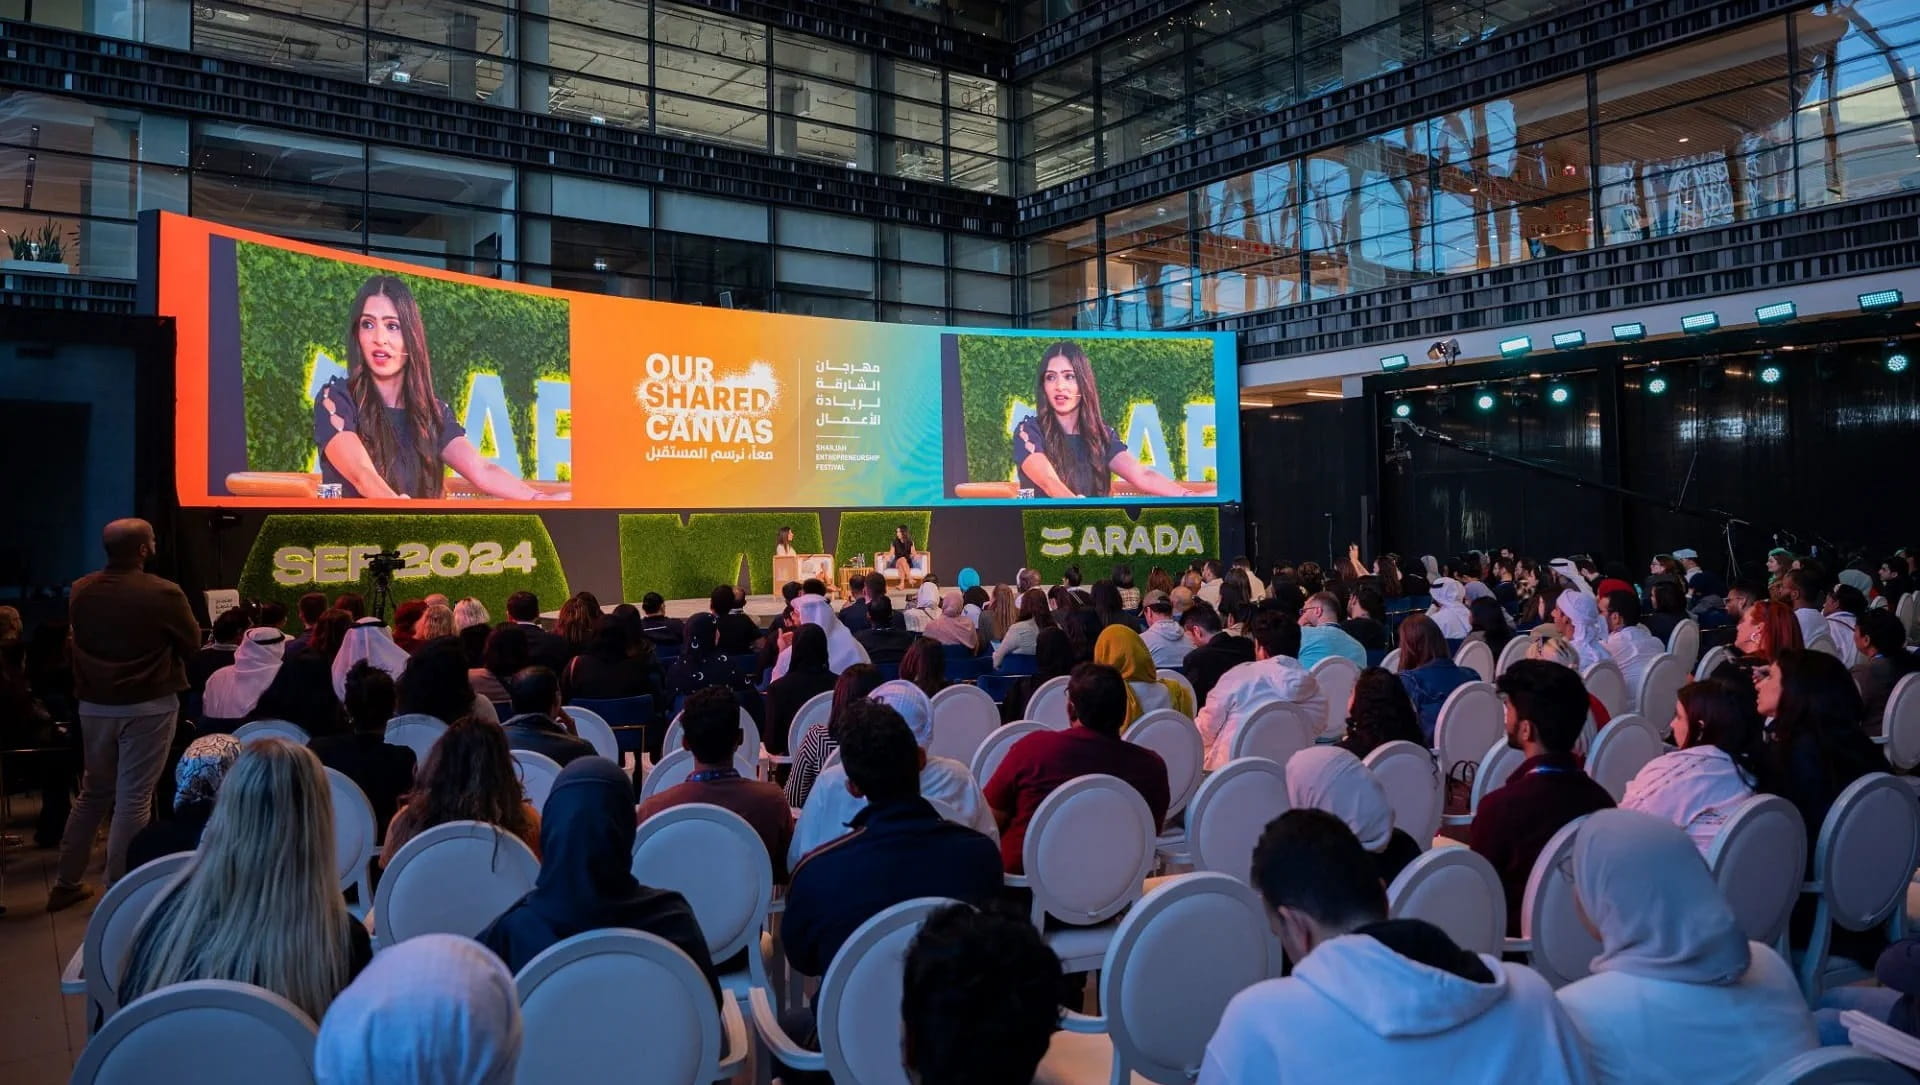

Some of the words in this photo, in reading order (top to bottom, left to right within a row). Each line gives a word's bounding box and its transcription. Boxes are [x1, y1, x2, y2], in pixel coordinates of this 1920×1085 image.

[645, 353, 714, 383] OUR
[815, 359, 880, 374] مهرجان
[815, 376, 880, 392] الشارقة
[645, 381, 771, 411] SHARED
[815, 393, 881, 410] لريادة
[815, 412, 881, 427] الأعمال
[645, 415, 774, 444] CANVAS
[645, 445, 708, 461] المستقبل
[711, 447, 745, 463] نرسم
[815, 453, 881, 462] ENTREPRENEURSHIP
[815, 463, 846, 471] FESTIVAL
[1078, 525, 1205, 556] ARADA
[393, 540, 538, 578] 2024
